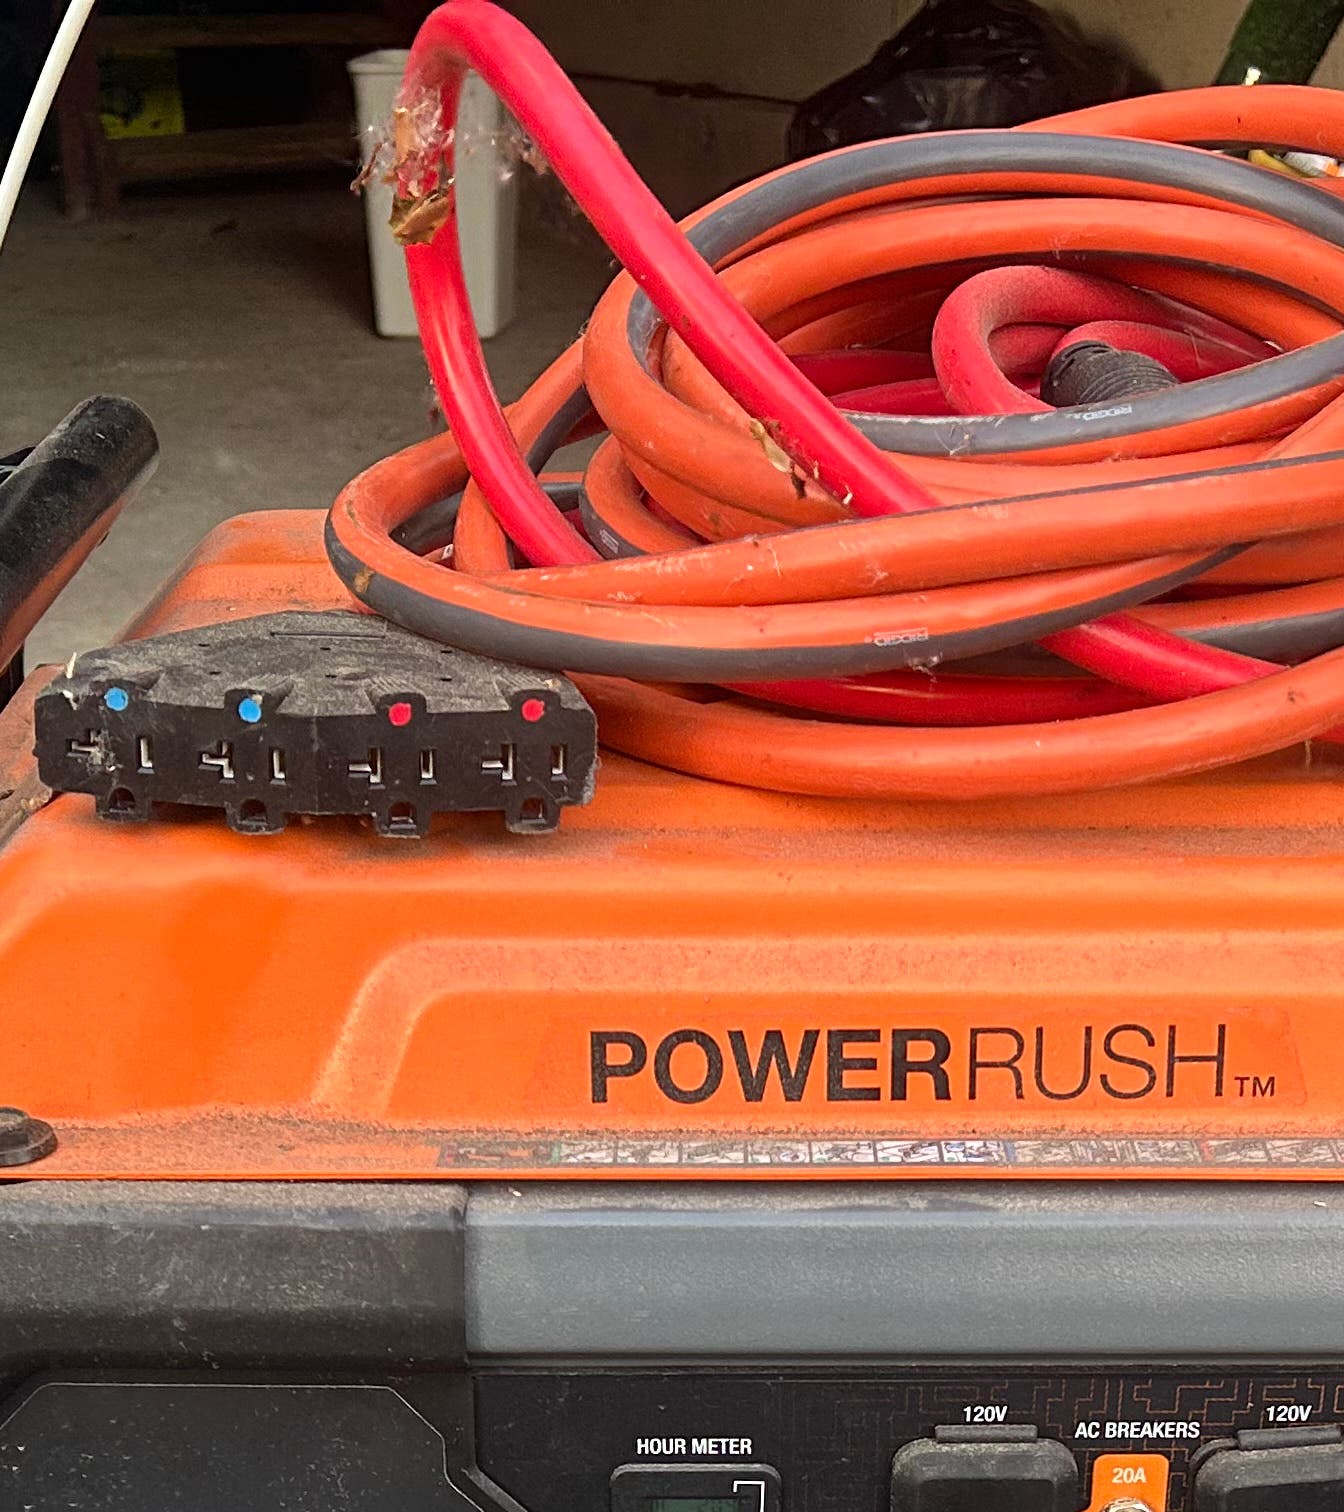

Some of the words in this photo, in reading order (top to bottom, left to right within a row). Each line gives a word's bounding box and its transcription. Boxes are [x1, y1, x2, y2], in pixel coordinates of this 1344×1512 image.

[589, 1022, 1224, 1105] POWERRUSH
[963, 1405, 1008, 1423] 120V
[1265, 1405, 1312, 1422] 120V
[1074, 1421, 1101, 1439] AC
[1104, 1421, 1201, 1439] BREAKERS
[636, 1437, 687, 1455] HOUR
[691, 1437, 752, 1455] METER
[1112, 1466, 1147, 1484] 20A
